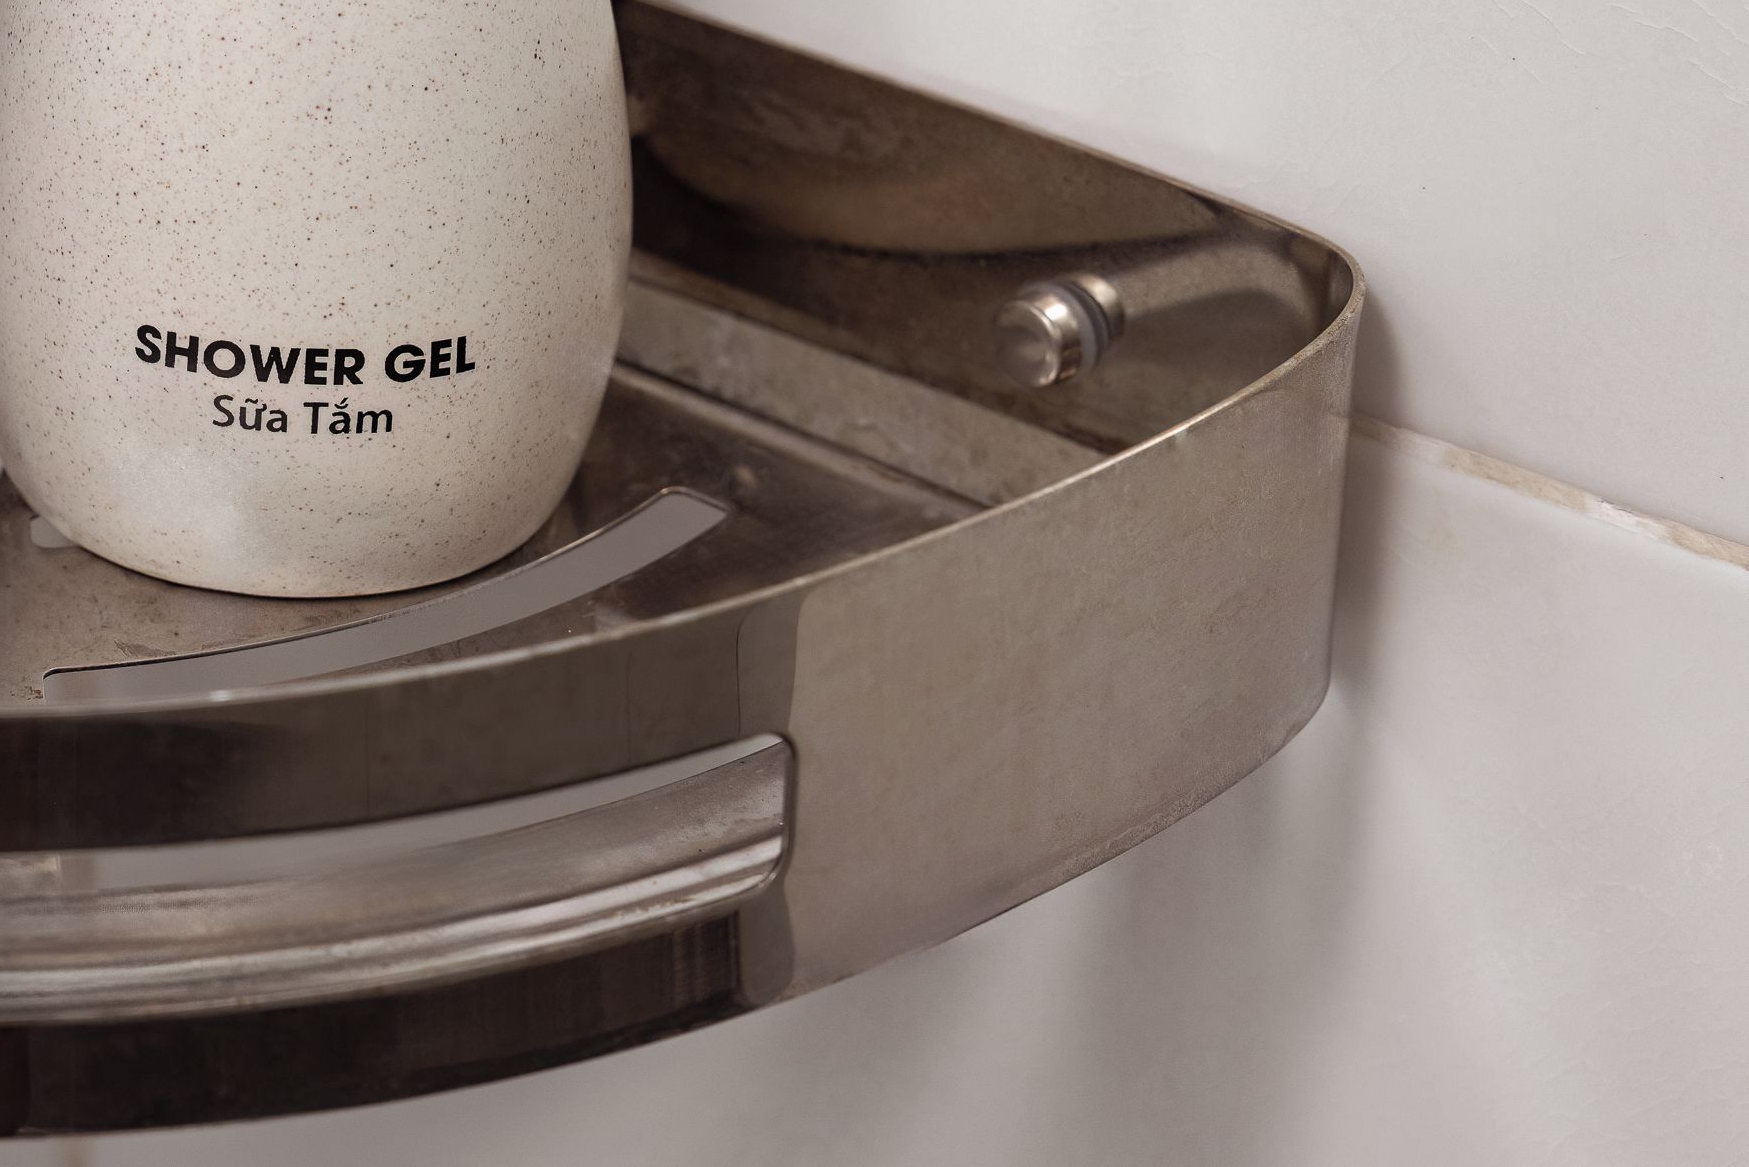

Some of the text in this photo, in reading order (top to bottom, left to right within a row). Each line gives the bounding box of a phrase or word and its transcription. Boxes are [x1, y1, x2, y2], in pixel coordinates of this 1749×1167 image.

[134, 324, 476, 386] SHOWER GEL
[212, 394, 394, 434] Sữa Tắm
